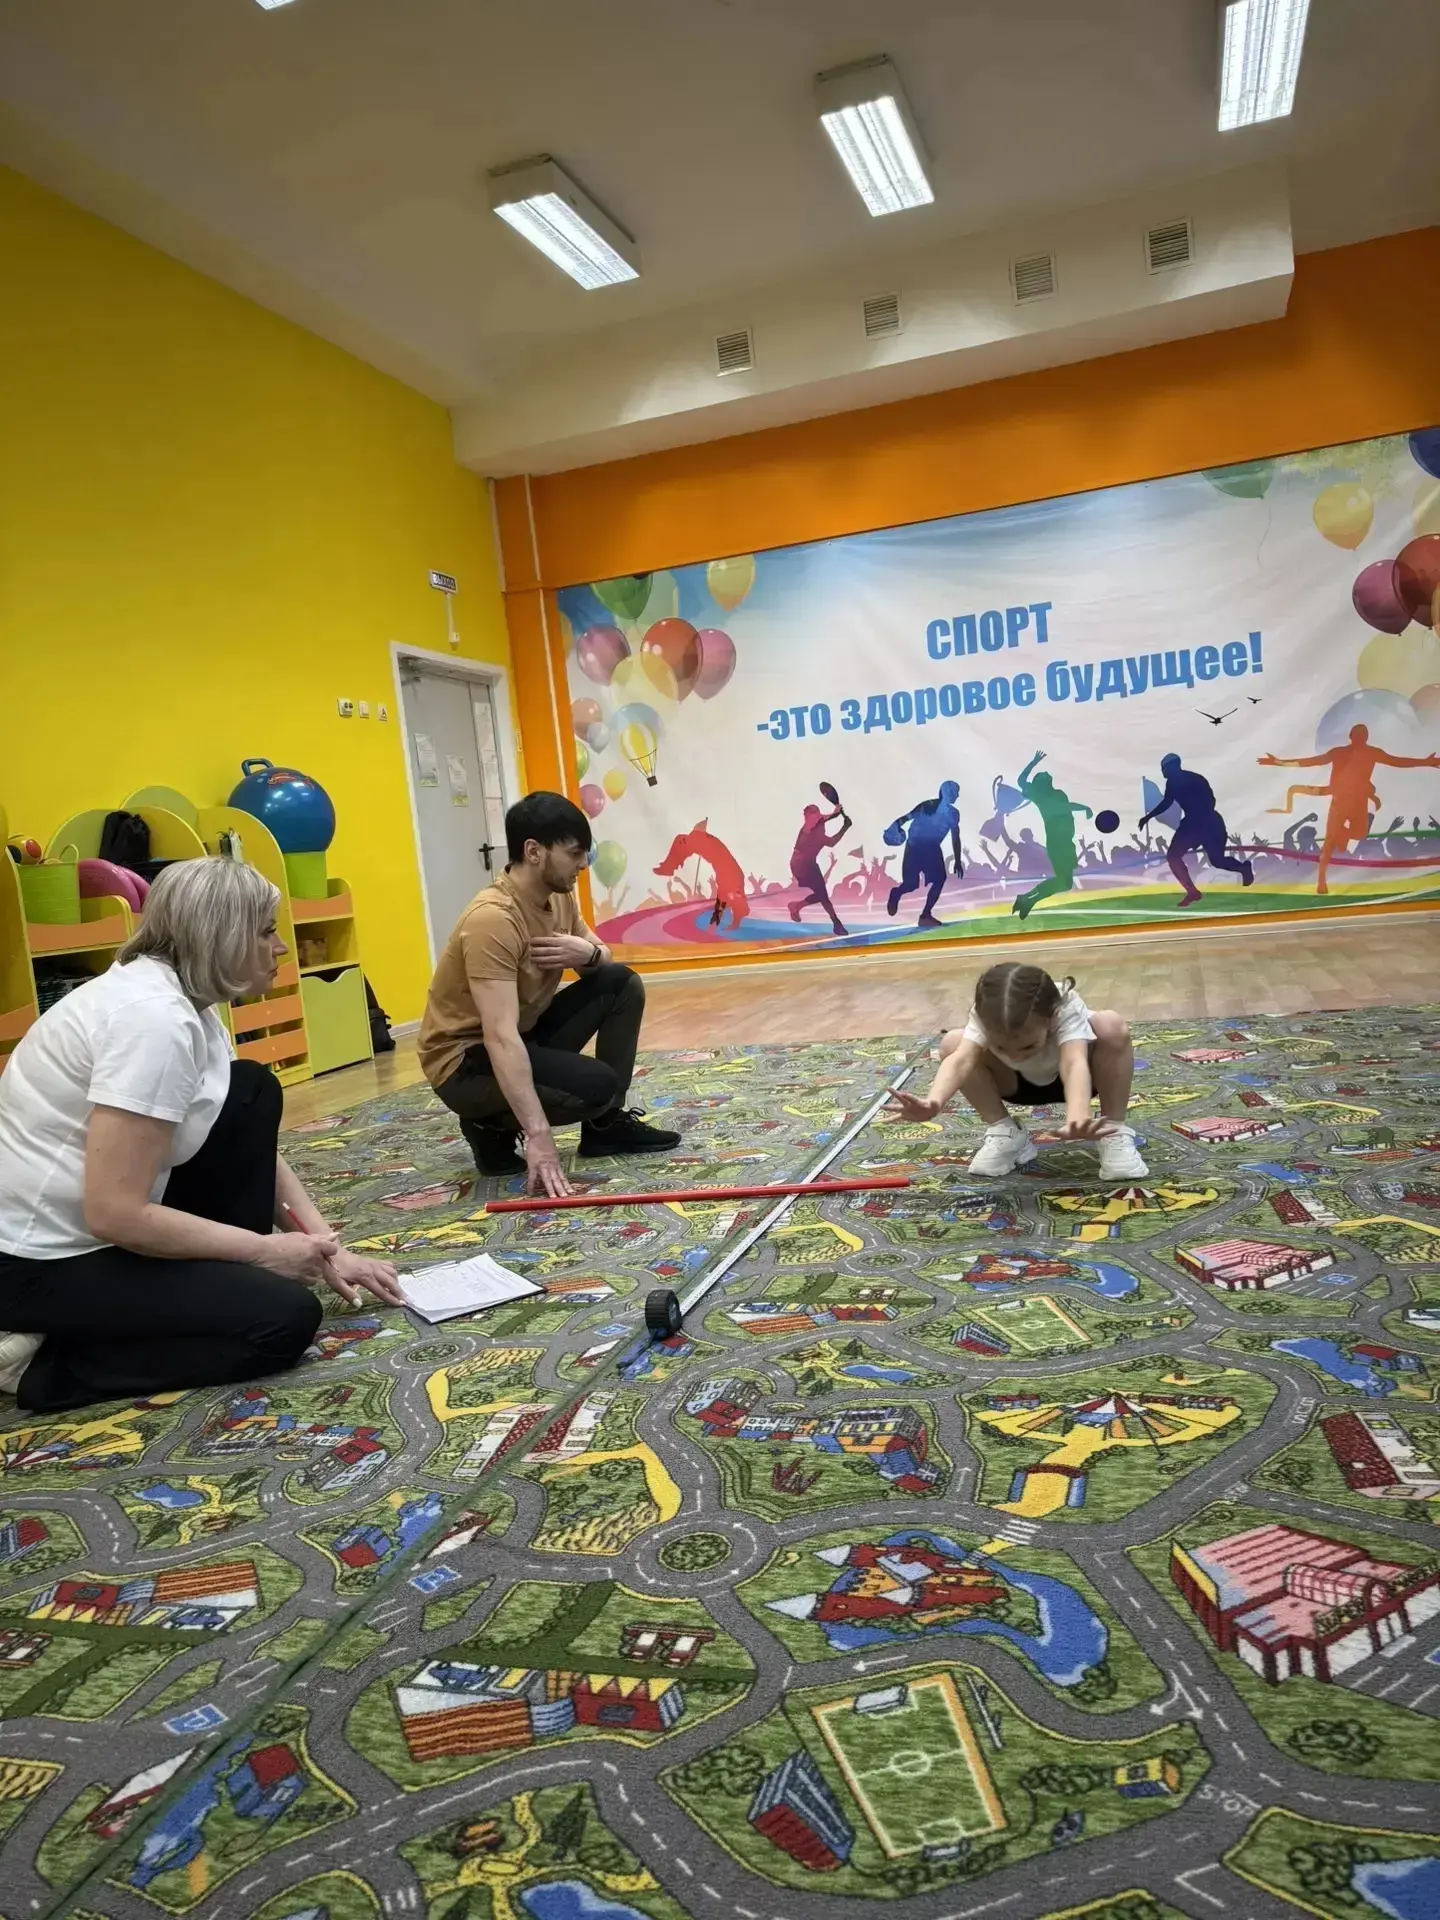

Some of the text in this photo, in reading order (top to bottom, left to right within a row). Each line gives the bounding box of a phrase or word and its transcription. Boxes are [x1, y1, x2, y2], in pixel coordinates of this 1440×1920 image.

[927, 602, 1053, 660] СПОРТ
[757, 632, 1264, 740] -это здоровое будущее!
